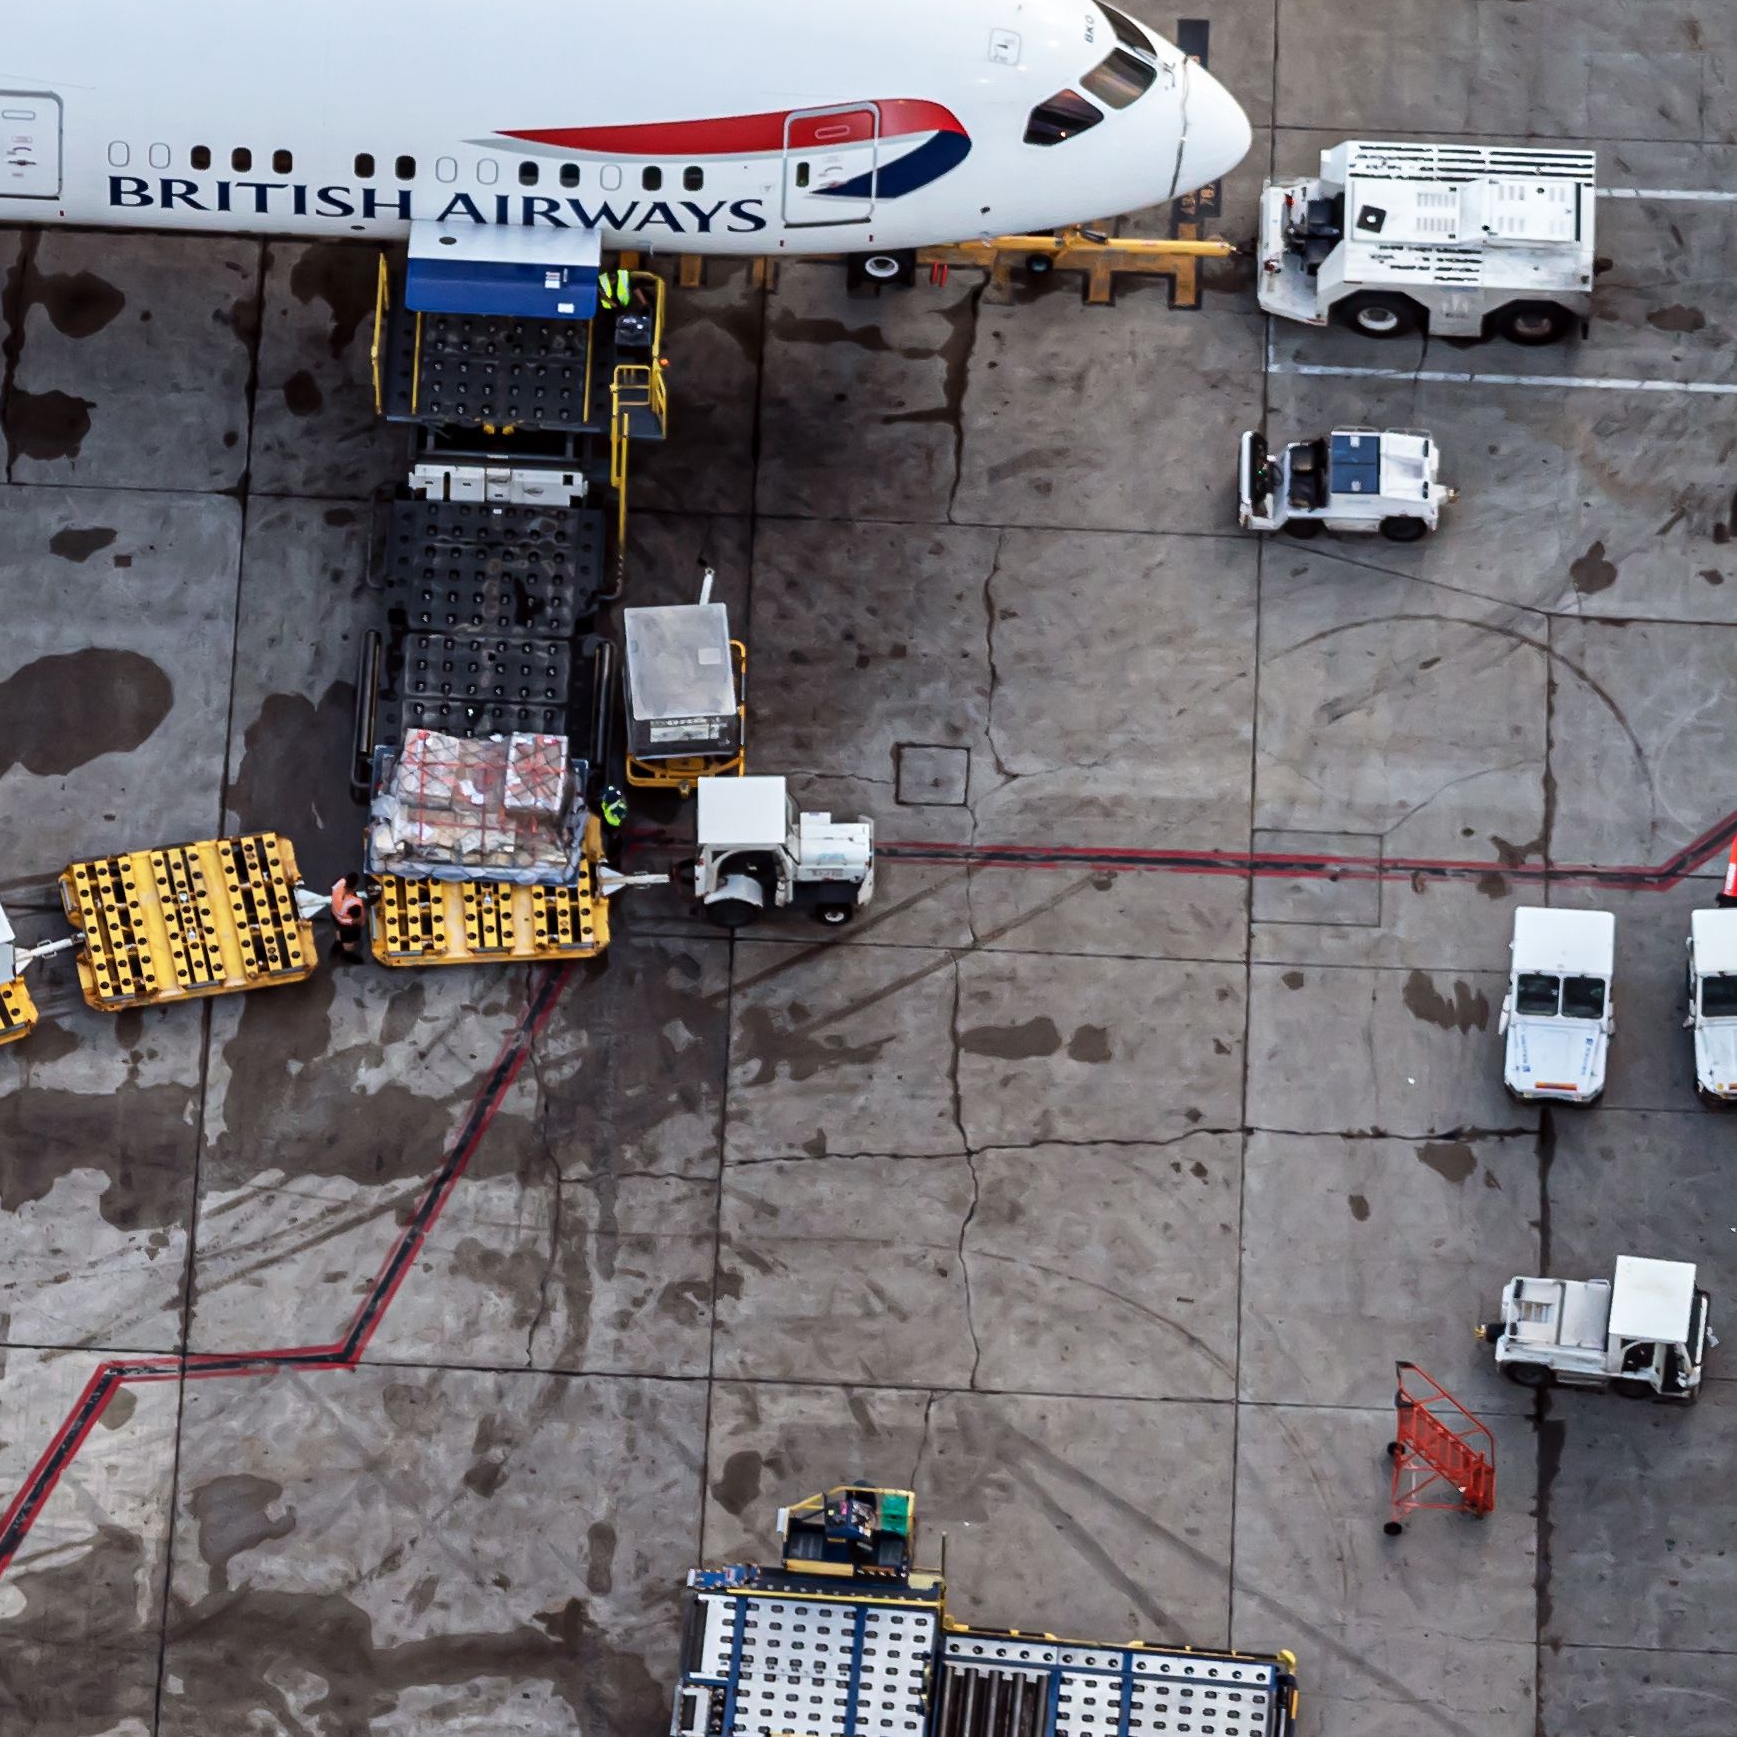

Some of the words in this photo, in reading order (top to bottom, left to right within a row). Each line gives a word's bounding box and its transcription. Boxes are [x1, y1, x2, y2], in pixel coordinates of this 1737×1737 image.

[1085, 14, 1096, 43] BKO
[106, 174, 414, 223] BRITISH
[434, 193, 768, 234] AIRWAYS
